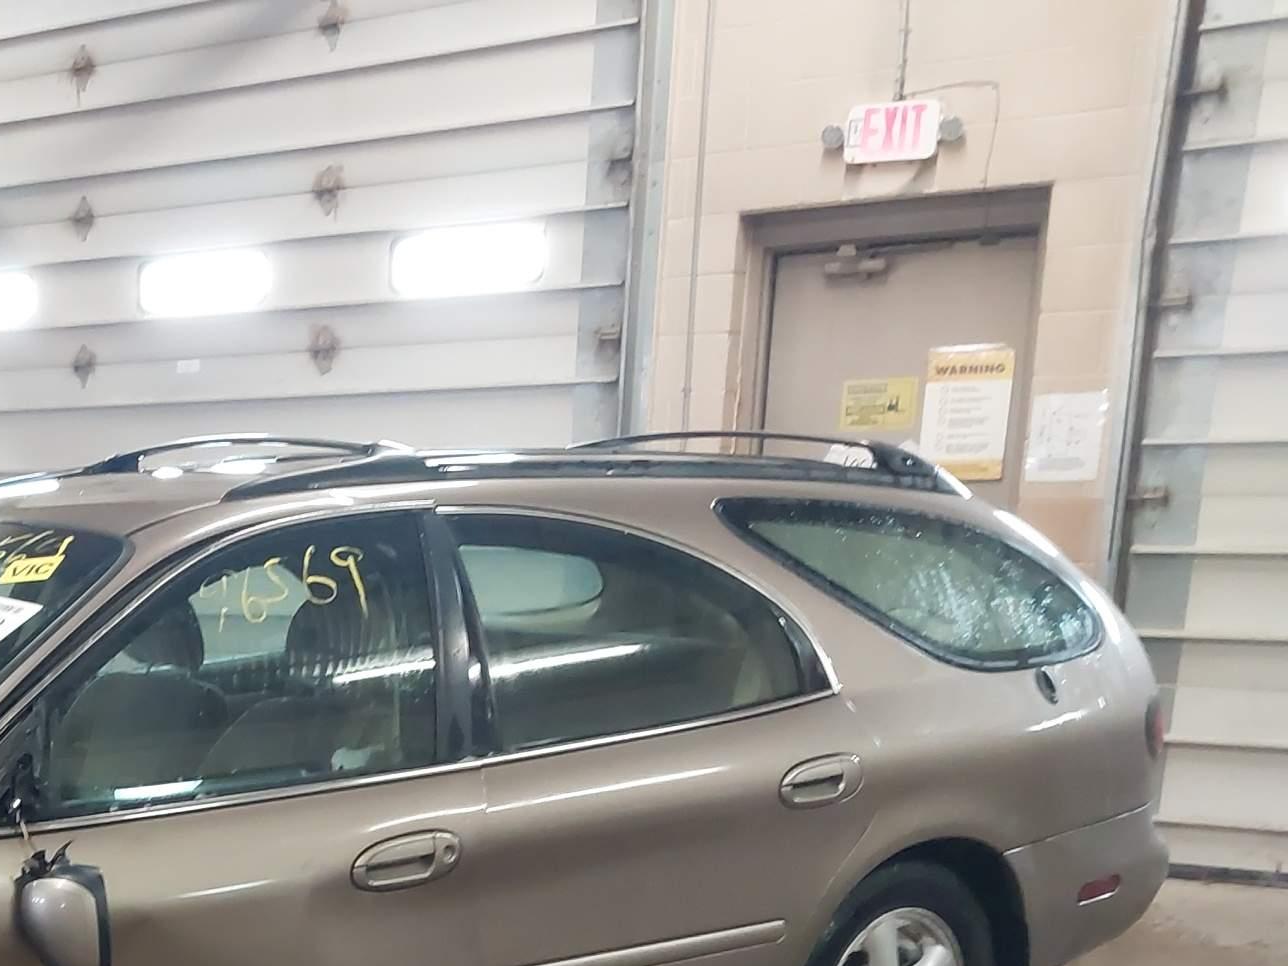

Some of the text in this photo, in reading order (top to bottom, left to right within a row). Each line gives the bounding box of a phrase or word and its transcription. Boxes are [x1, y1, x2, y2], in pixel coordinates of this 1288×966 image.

[860, 104, 928, 152] EXIT
[935, 362, 1006, 377] WARNING
[11, 562, 54, 577] VIC
